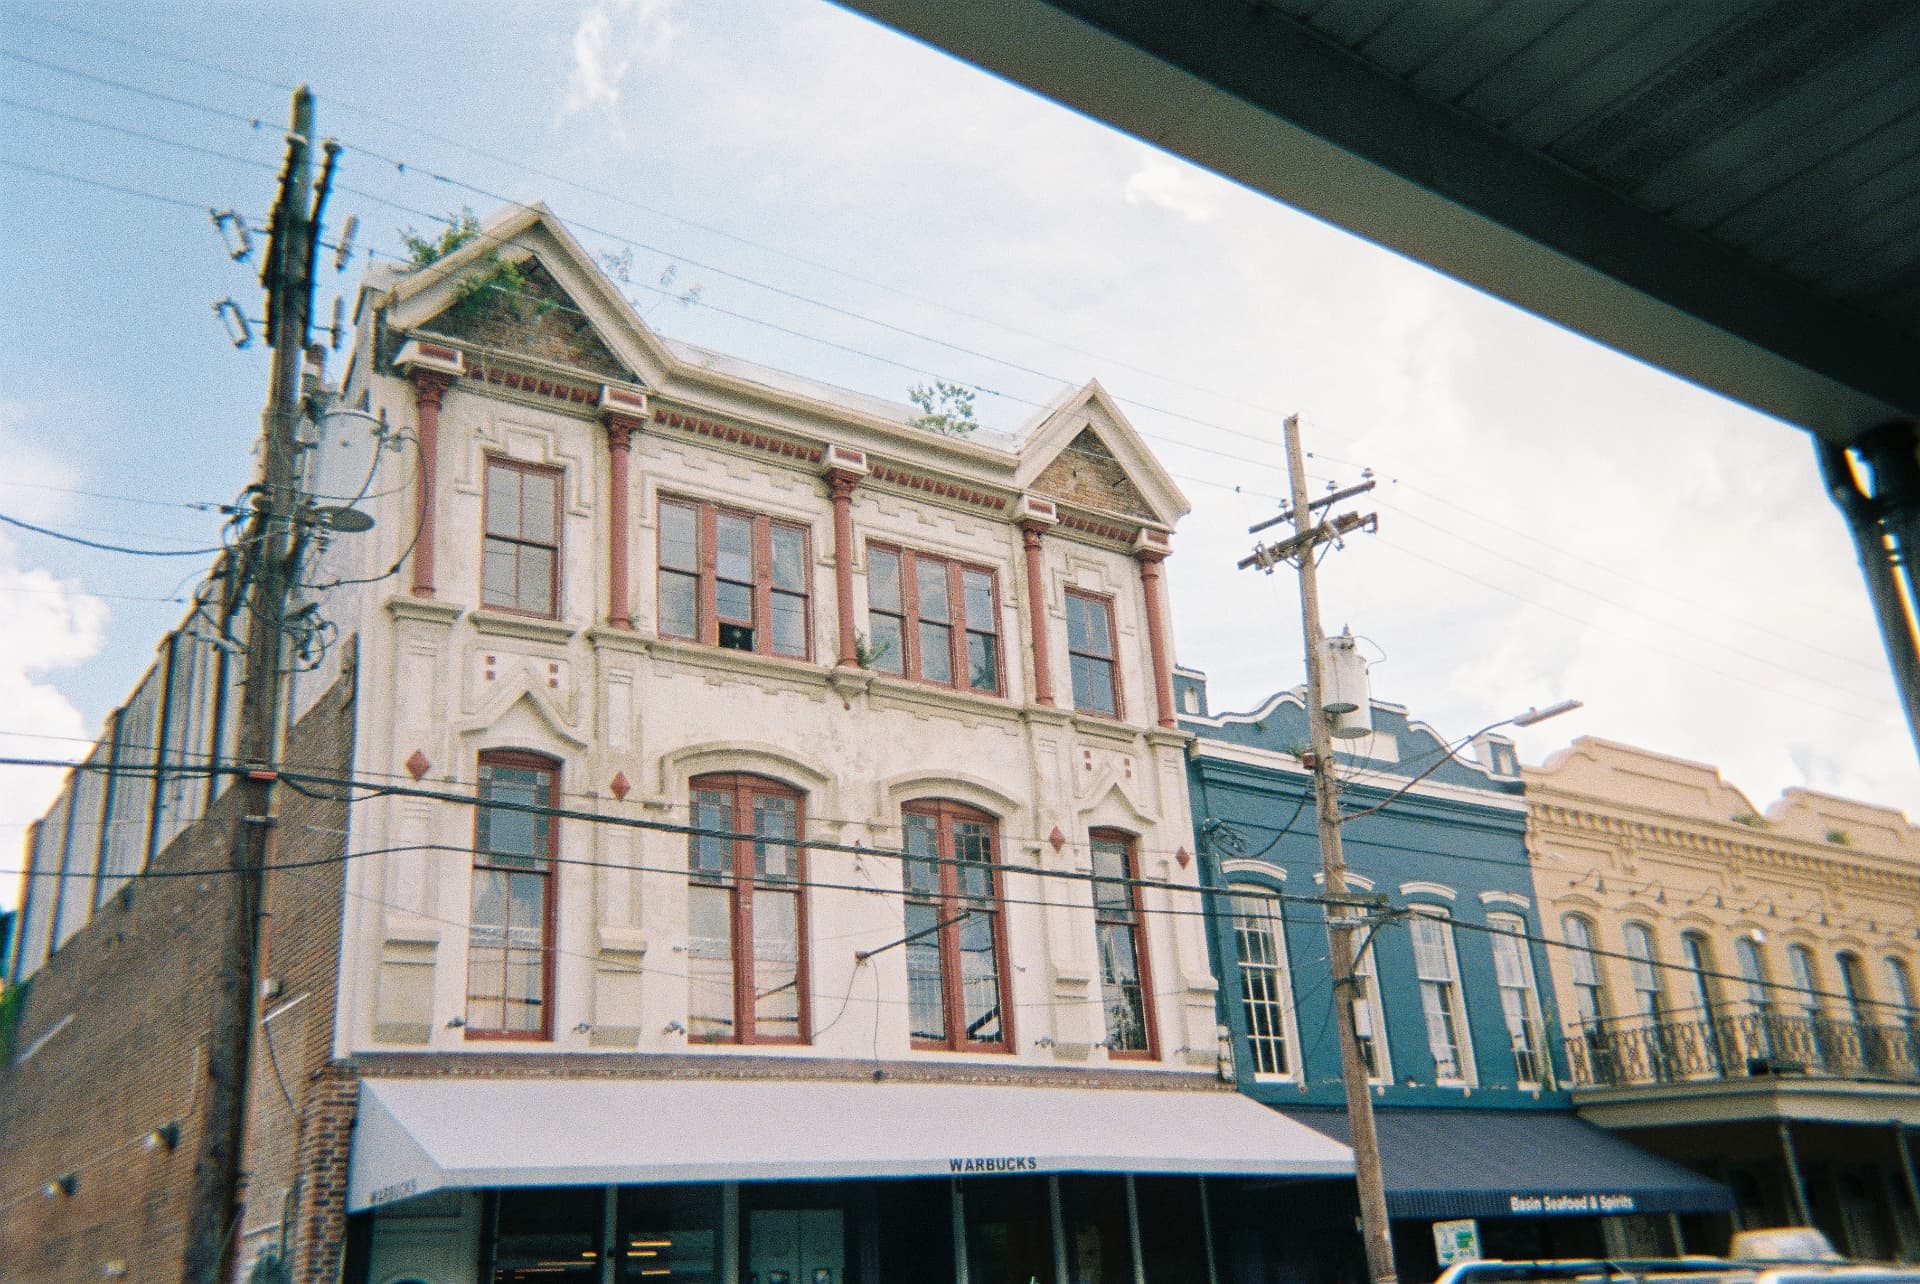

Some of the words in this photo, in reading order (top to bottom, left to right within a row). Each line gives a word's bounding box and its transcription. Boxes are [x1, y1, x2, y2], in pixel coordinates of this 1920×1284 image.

[949, 1157, 1037, 1172] WARBUCKS
[1543, 1195, 1587, 1210] Seafood
[1589, 1195, 1598, 1209] &
[1599, 1194, 1634, 1211] Spirits
